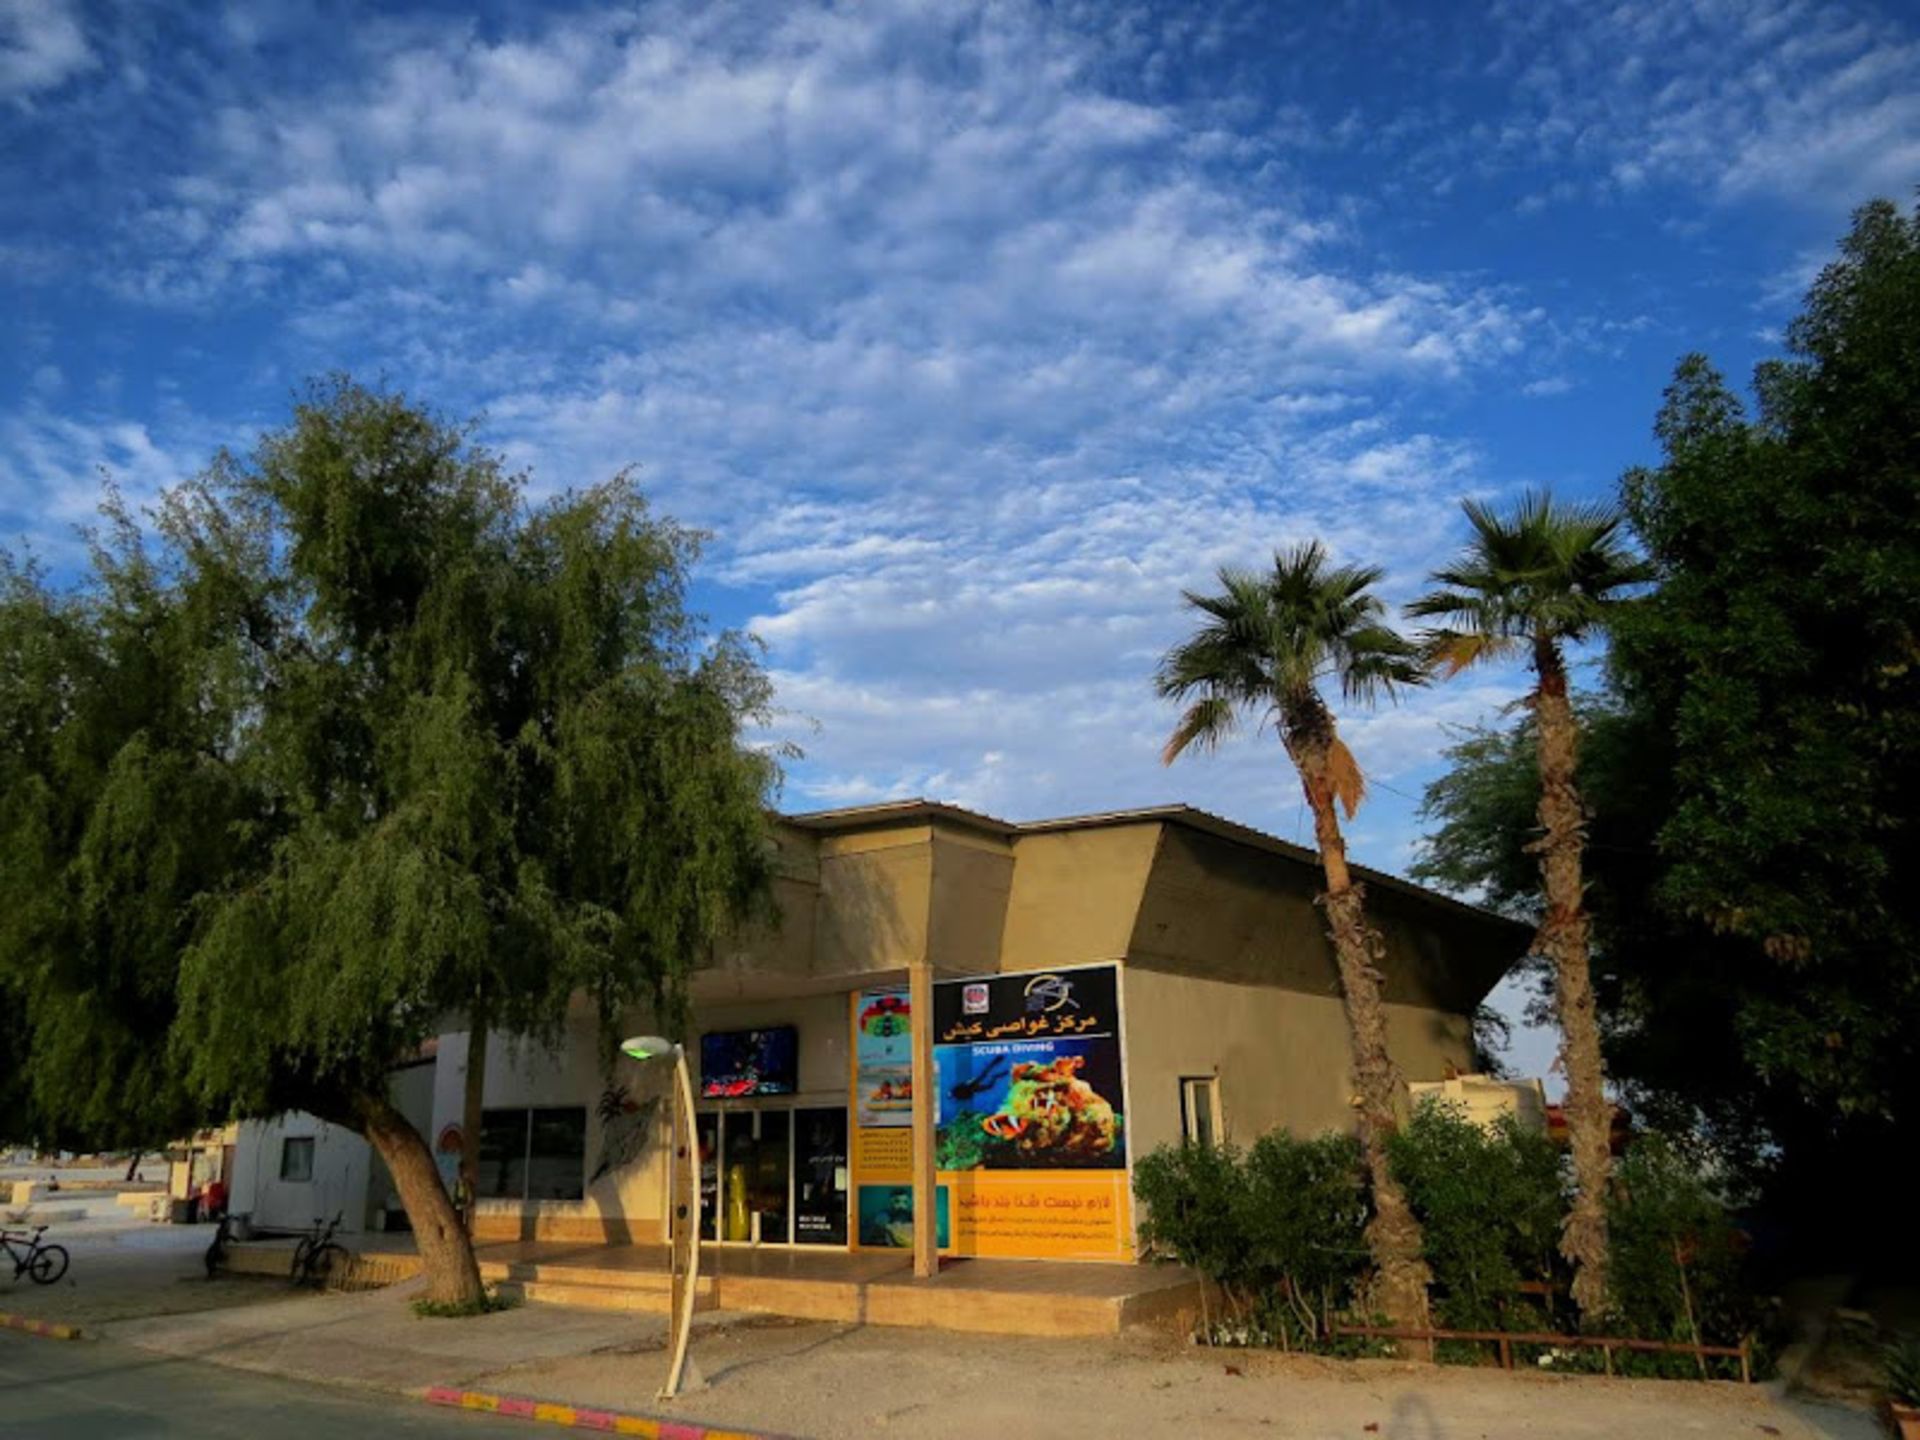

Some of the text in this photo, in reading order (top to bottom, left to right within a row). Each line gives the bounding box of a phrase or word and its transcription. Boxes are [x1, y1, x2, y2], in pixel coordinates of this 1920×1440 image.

[943, 1014, 1098, 1041] مرکز غواصی کیش
[972, 1042, 1055, 1056] SCUBA DIVING
